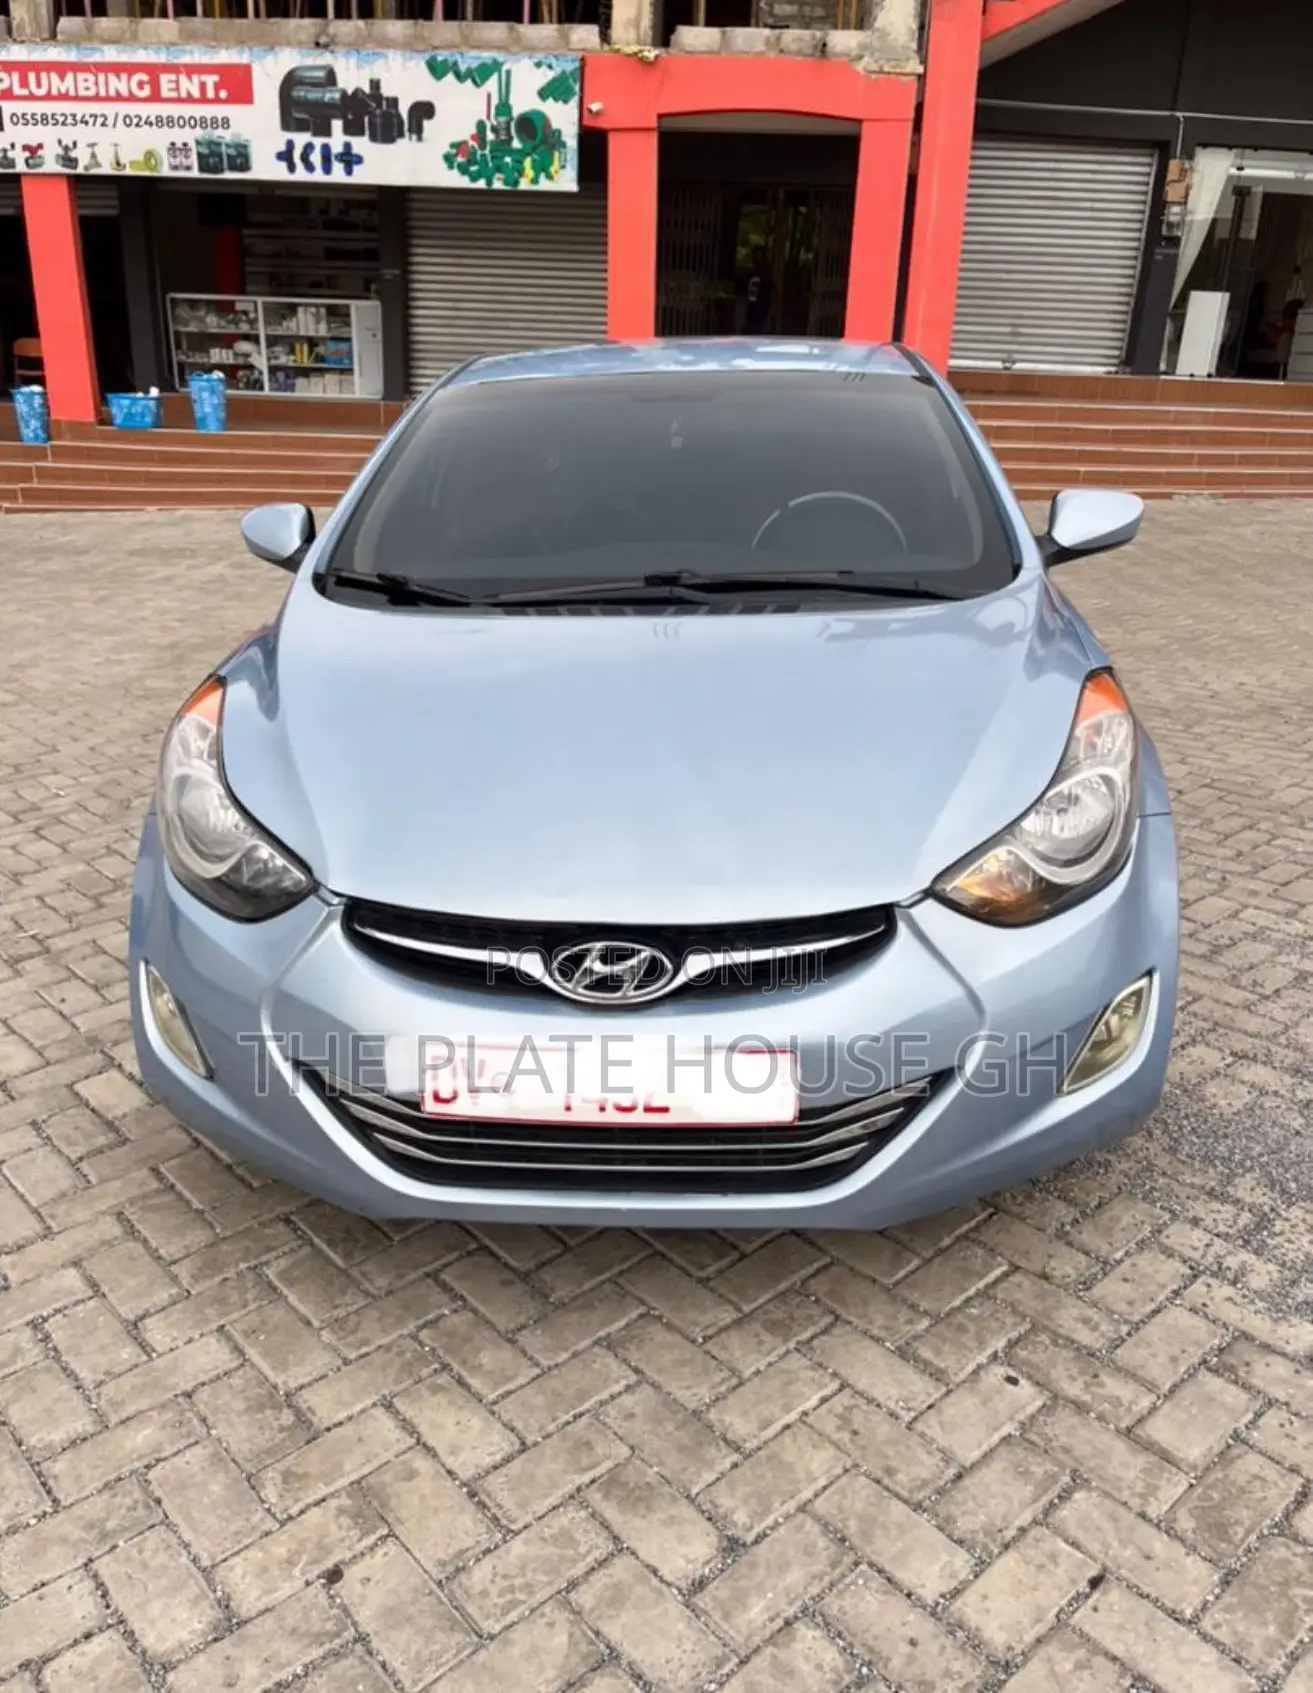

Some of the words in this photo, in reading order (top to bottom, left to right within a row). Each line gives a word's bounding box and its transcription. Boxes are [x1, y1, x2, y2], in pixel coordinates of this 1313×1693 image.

[0, 71, 151, 98] PLUMBING
[160, 74, 228, 99] ENT.
[10, 112, 109, 128] 0558523472
[123, 114, 231, 130] 0248800888
